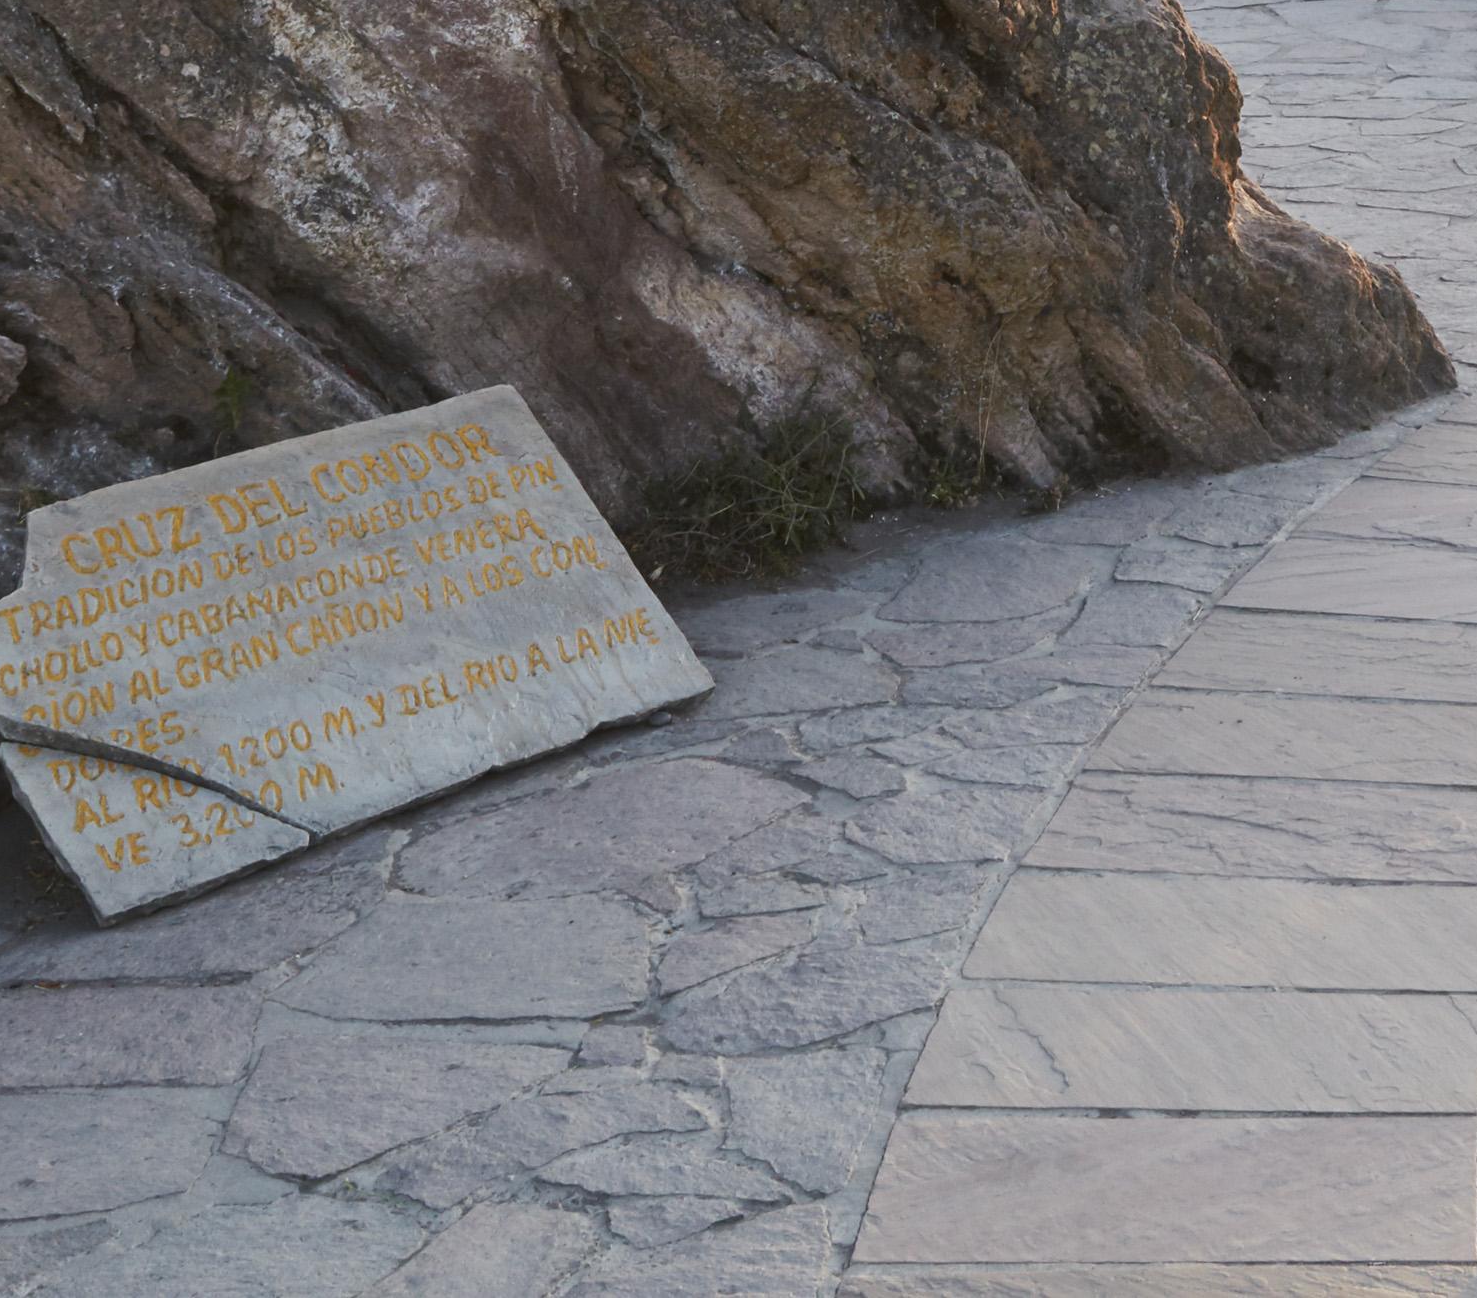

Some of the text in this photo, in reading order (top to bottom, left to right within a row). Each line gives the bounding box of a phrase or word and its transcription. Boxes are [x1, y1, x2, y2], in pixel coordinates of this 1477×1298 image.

[61, 423, 502, 574] CRUZ DEL CONDOR
[327, 485, 463, 548] PUEBLOS
[413, 508, 548, 567] VENERA
[130, 667, 171, 704] AL
[176, 630, 280, 689] GRAN
[412, 582, 434, 613] Y
[441, 575, 465, 605] A
[465, 555, 525, 598] LOS
[73, 794, 125, 834] AL
[396, 672, 459, 716] DEL
[463, 654, 518, 695] RIO
[527, 642, 552, 677] A
[555, 627, 601, 664] LA
[95, 831, 151, 873] VE
